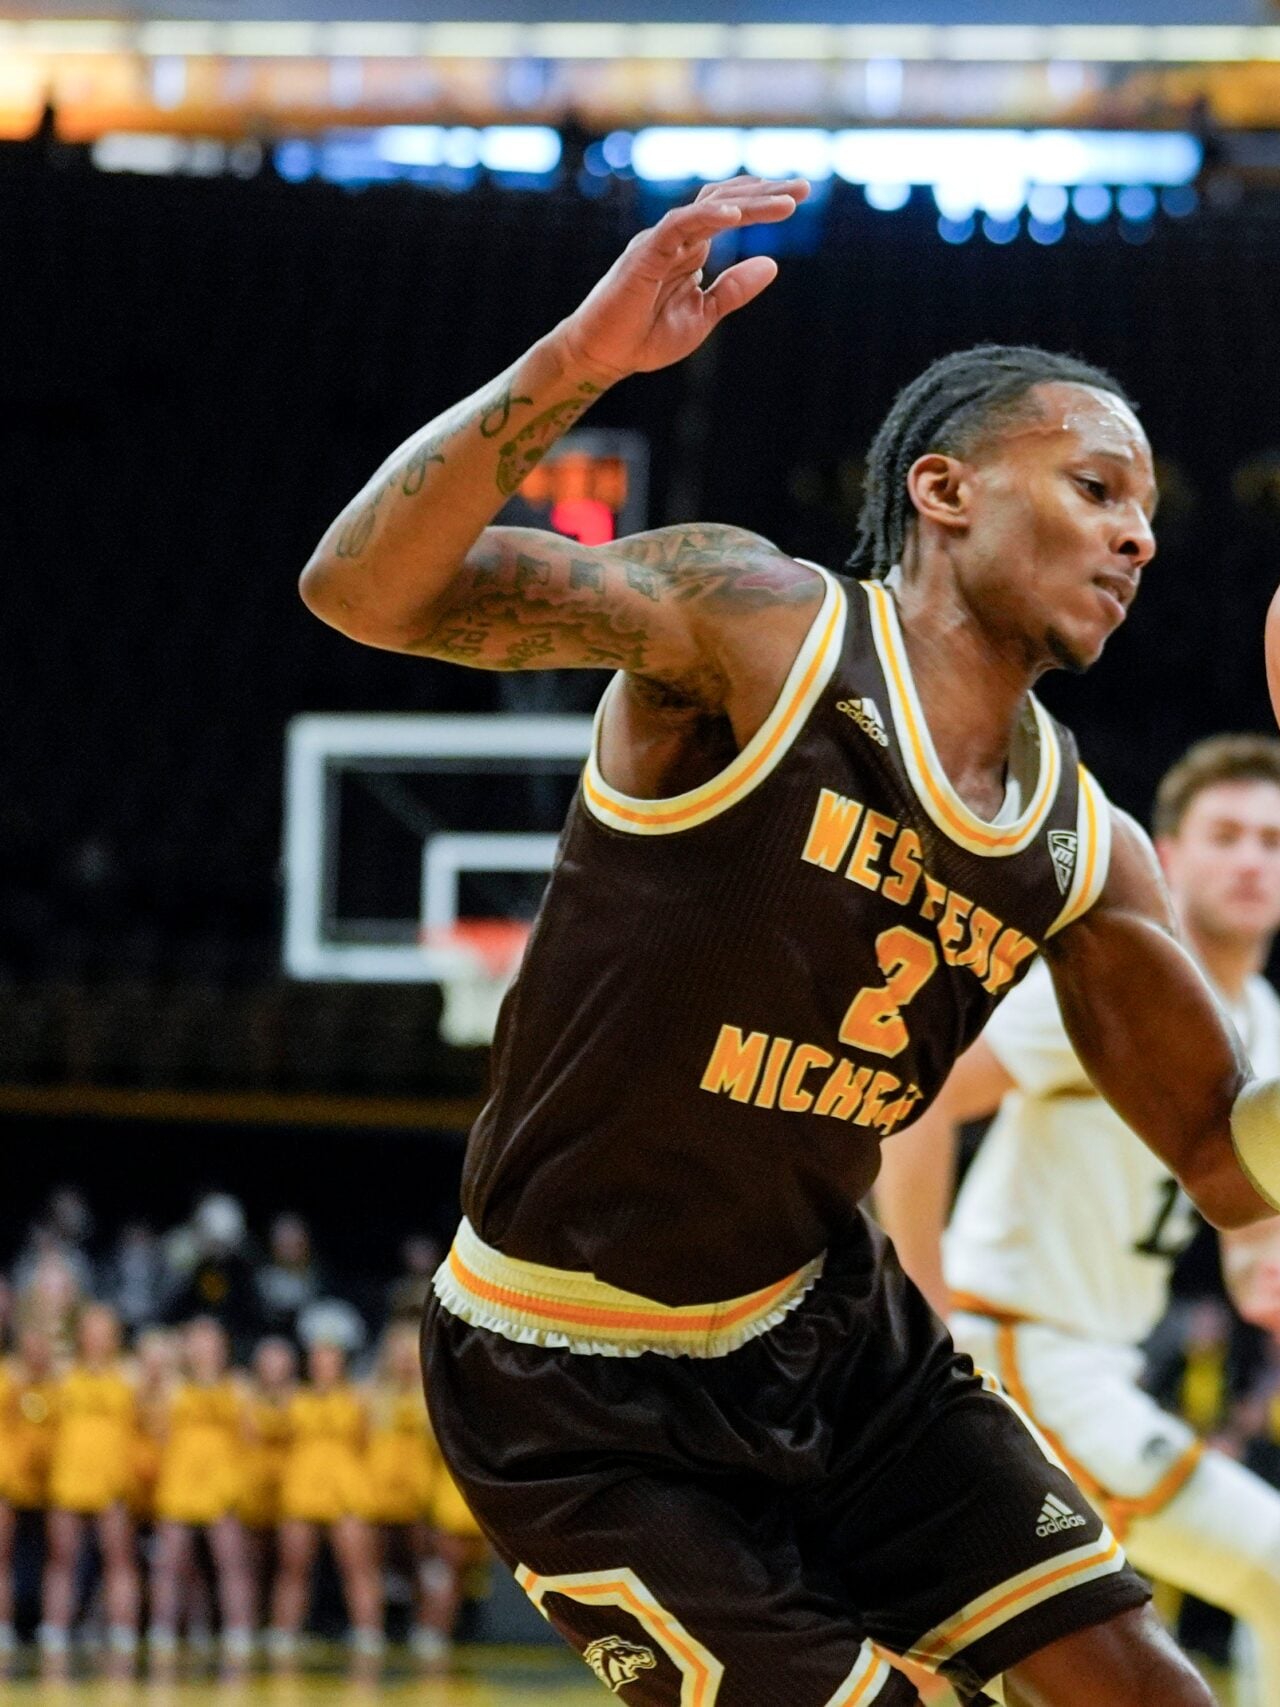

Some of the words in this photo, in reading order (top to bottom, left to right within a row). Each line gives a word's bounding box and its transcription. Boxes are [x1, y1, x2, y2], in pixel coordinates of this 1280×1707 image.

[835, 700, 889, 748] adidas
[800, 787, 1038, 996] WESTERN
[838, 924, 939, 1059] 2
[1035, 1514, 1087, 1538] adidas
